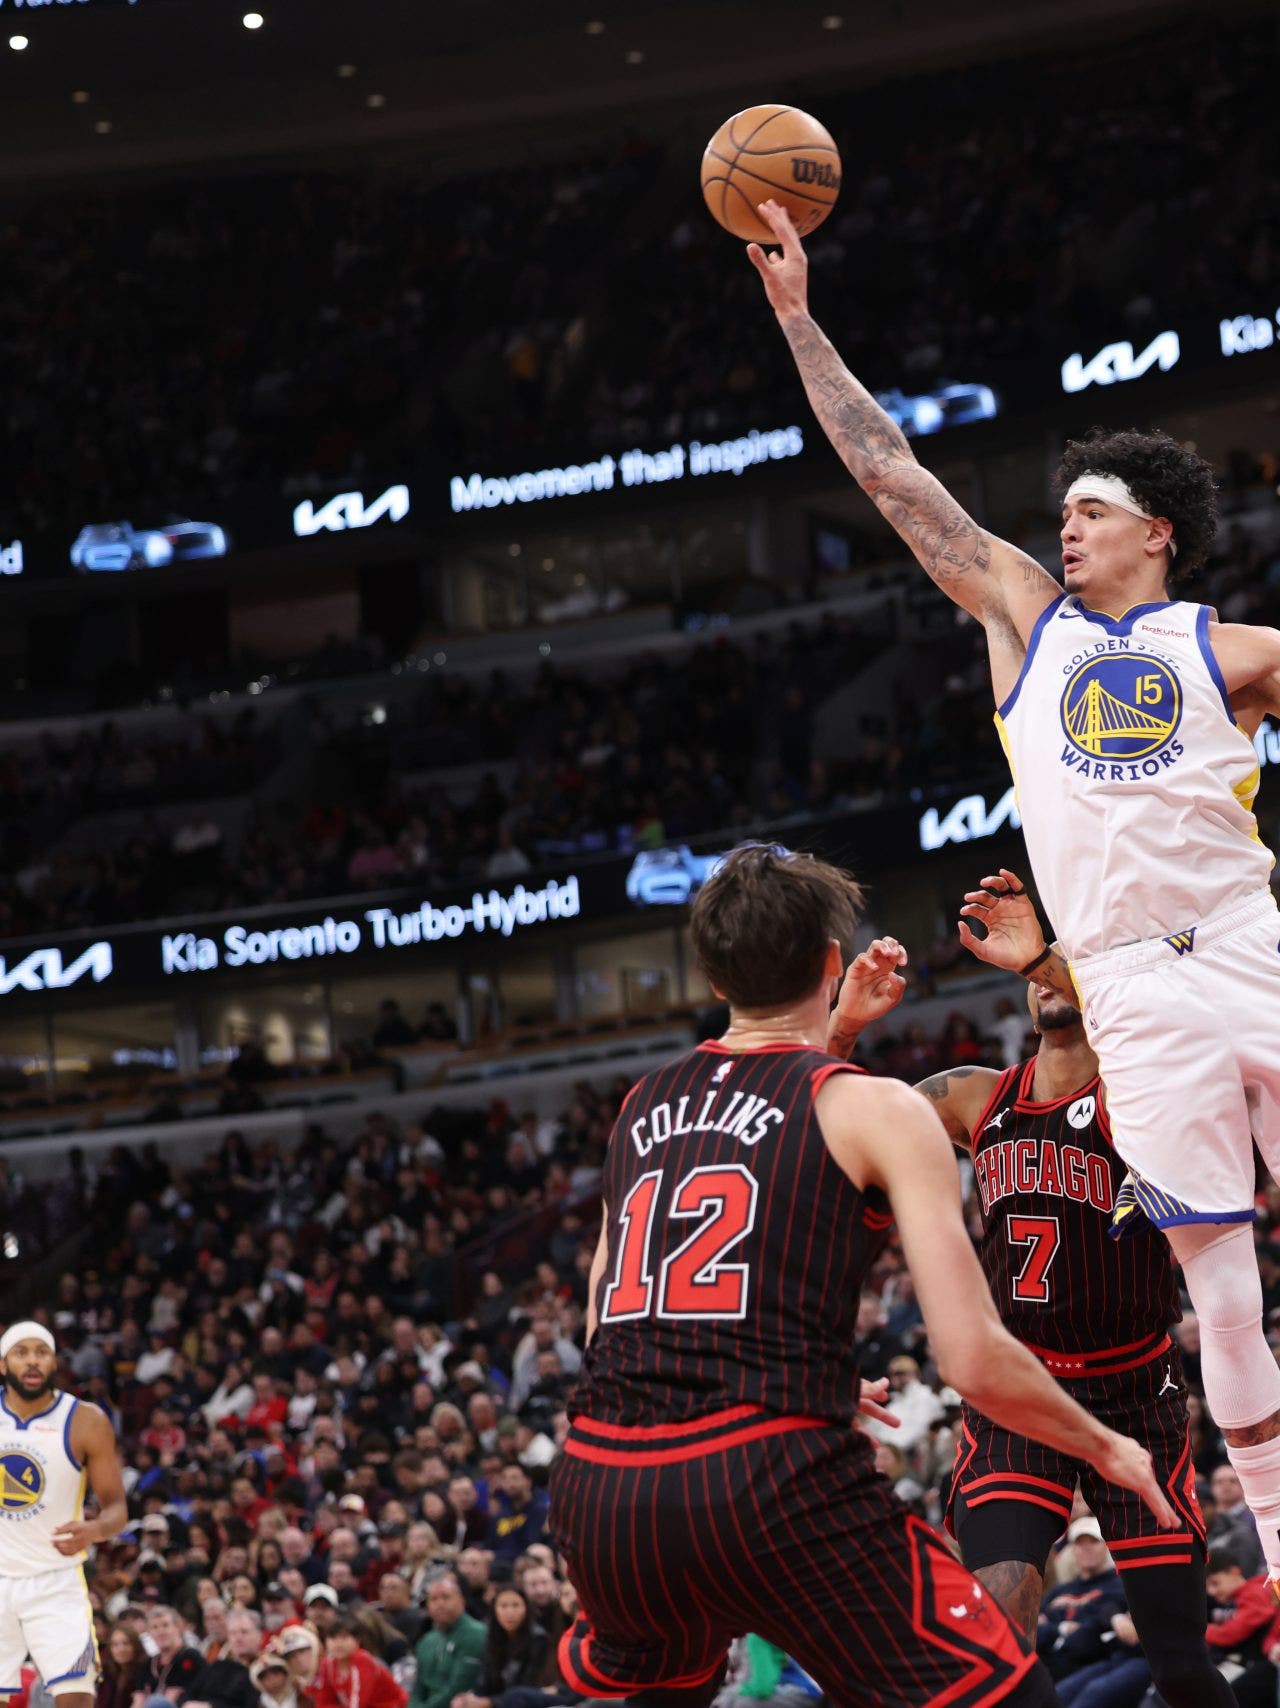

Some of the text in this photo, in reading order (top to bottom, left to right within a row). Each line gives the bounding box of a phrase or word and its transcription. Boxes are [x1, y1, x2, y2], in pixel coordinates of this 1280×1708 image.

[1219, 315, 1274, 356] Kia
[450, 426, 804, 513] Movement that inspires
[1063, 638, 1129, 675] GOLDEN
[1141, 624, 1189, 639] Rakuten
[1135, 673, 1163, 705] 15
[1060, 739, 1185, 782] WARRIORS
[161, 875, 580, 973] Kia Sorento Turbo-Hybrid
[630, 1090, 785, 1158] COLLINS
[974, 1138, 1114, 1217] CHICAGO
[600, 1163, 760, 1324] 12
[1006, 1213, 1061, 1303] 7
